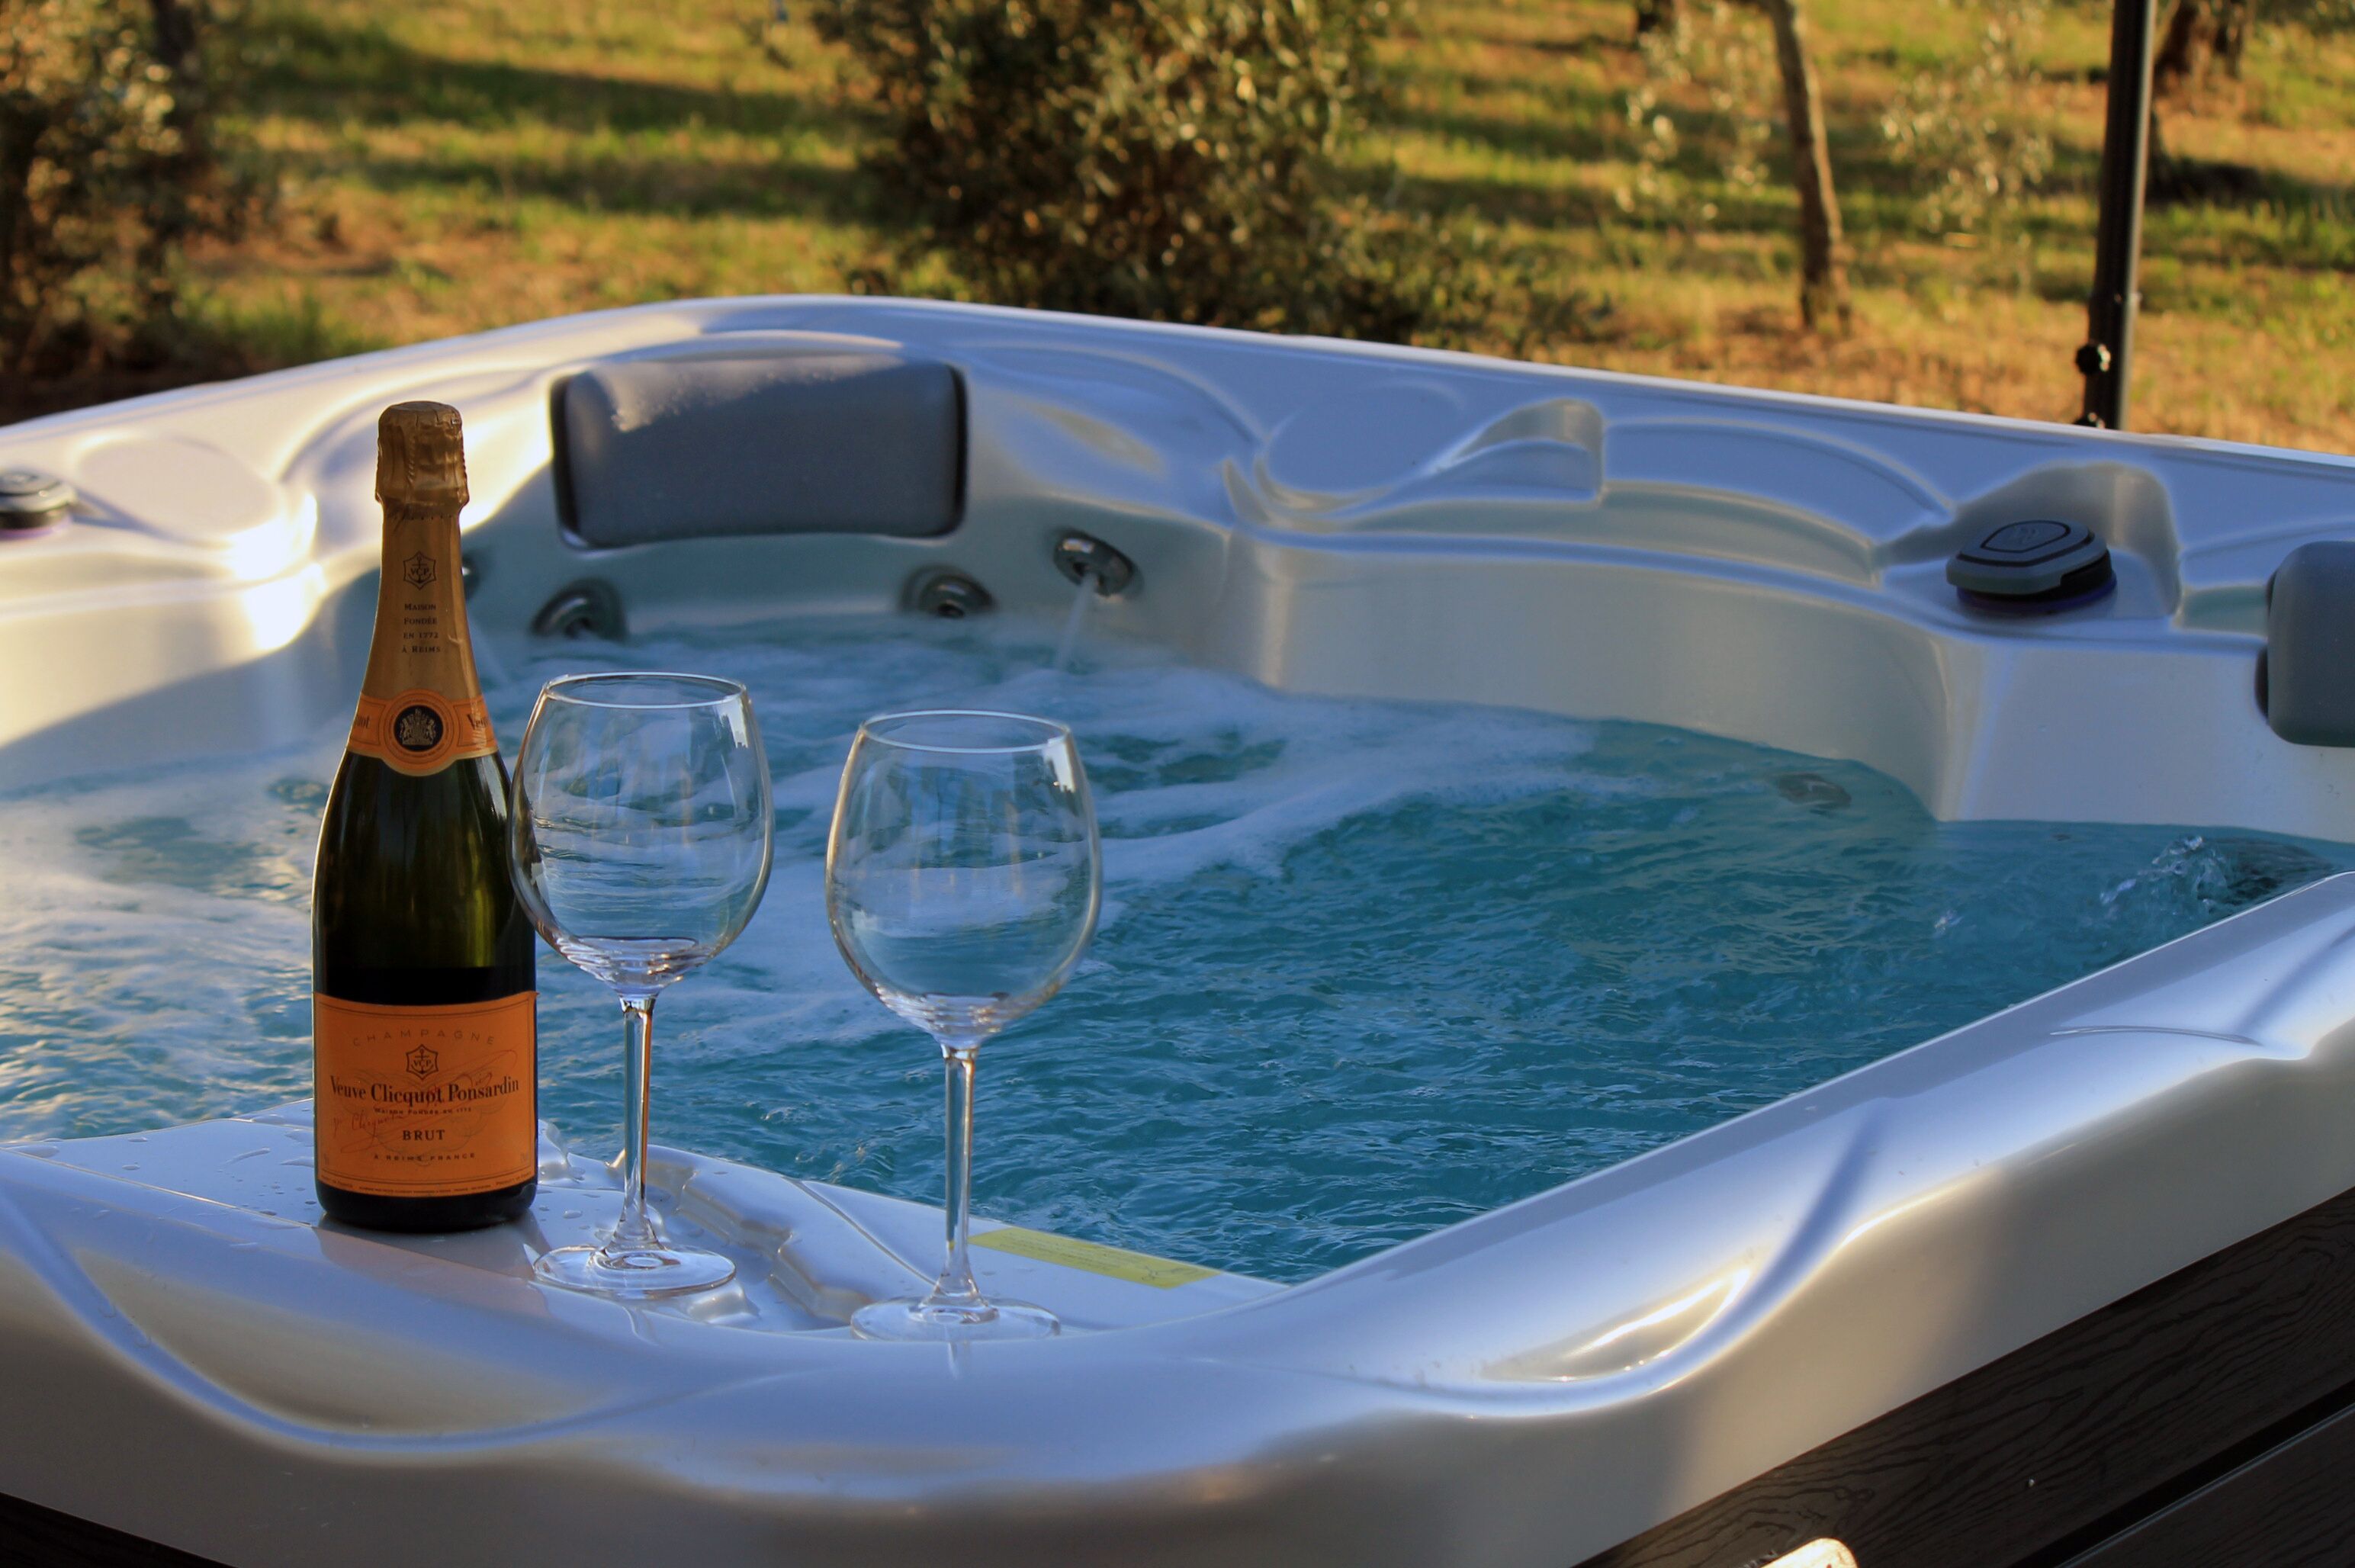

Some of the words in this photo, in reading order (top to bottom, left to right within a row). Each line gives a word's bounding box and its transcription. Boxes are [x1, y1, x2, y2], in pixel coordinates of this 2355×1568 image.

[410, 567, 430, 576] VCP
[352, 1029, 495, 1046] CHAMPAGNE
[329, 1075, 367, 1100] Veuve
[371, 1082, 445, 1108] Clicquot
[448, 1075, 519, 1102] Ponsardin
[402, 1129, 445, 1141] BRUT
[429, 1152, 475, 1162] FRANCE
